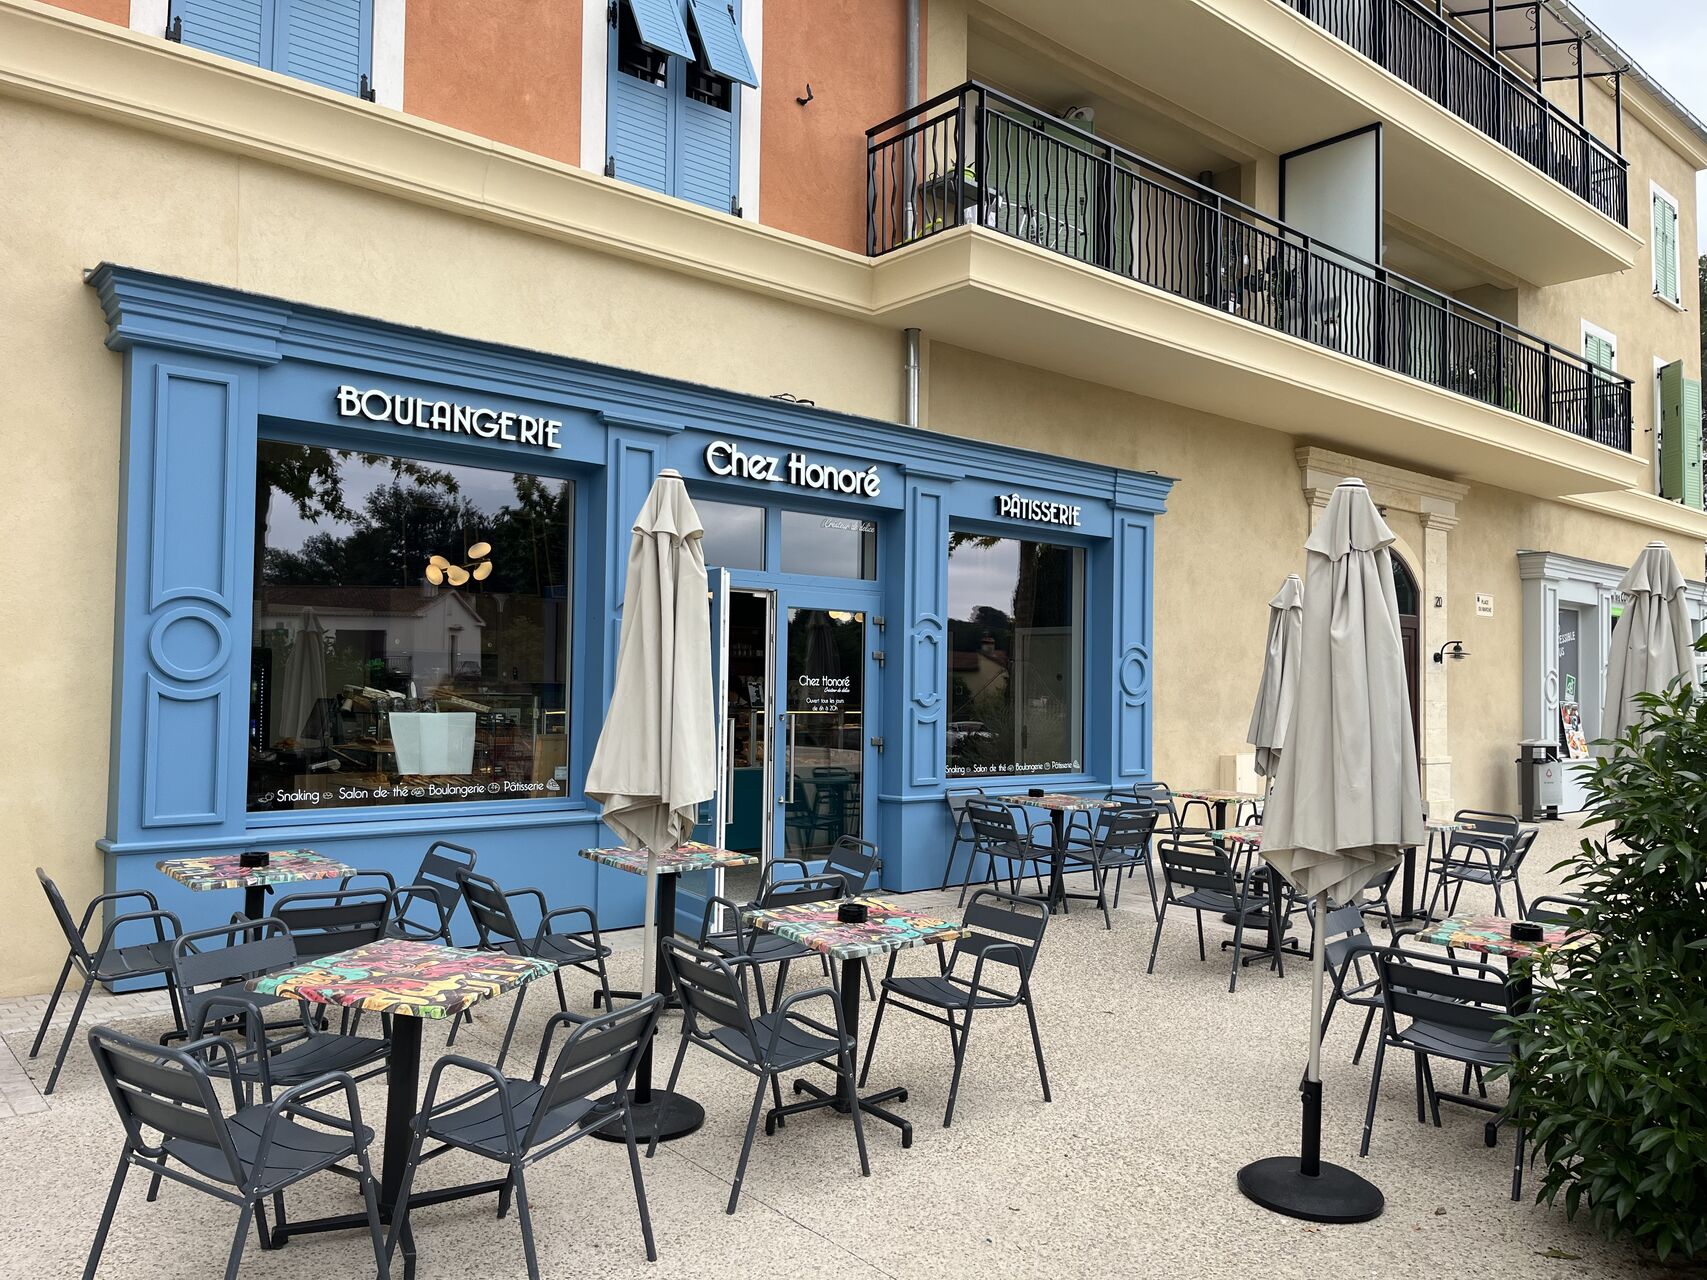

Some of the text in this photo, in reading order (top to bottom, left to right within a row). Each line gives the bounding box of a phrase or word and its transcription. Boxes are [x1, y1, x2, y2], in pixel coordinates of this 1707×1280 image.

[337, 385, 562, 448] BOULANGERIE
[705, 440, 880, 497] Chez Honoré
[998, 493, 1081, 526] PÂTISSERIE
[1434, 596, 1442, 608] 20
[798, 675, 850, 687] Chez Honoré
[973, 763, 987, 773] Salon
[989, 763, 997, 773] de
[998, 763, 1006, 772] thé
[1016, 762, 1043, 773] Boulangerie
[1052, 760, 1072, 769] Pâtisserie
[276, 789, 320, 804] Snaking
[338, 787, 368, 800] Salon
[393, 785, 409, 797] thé
[428, 783, 485, 797] Boulangerie
[504, 780, 544, 792] Pâtisserie
